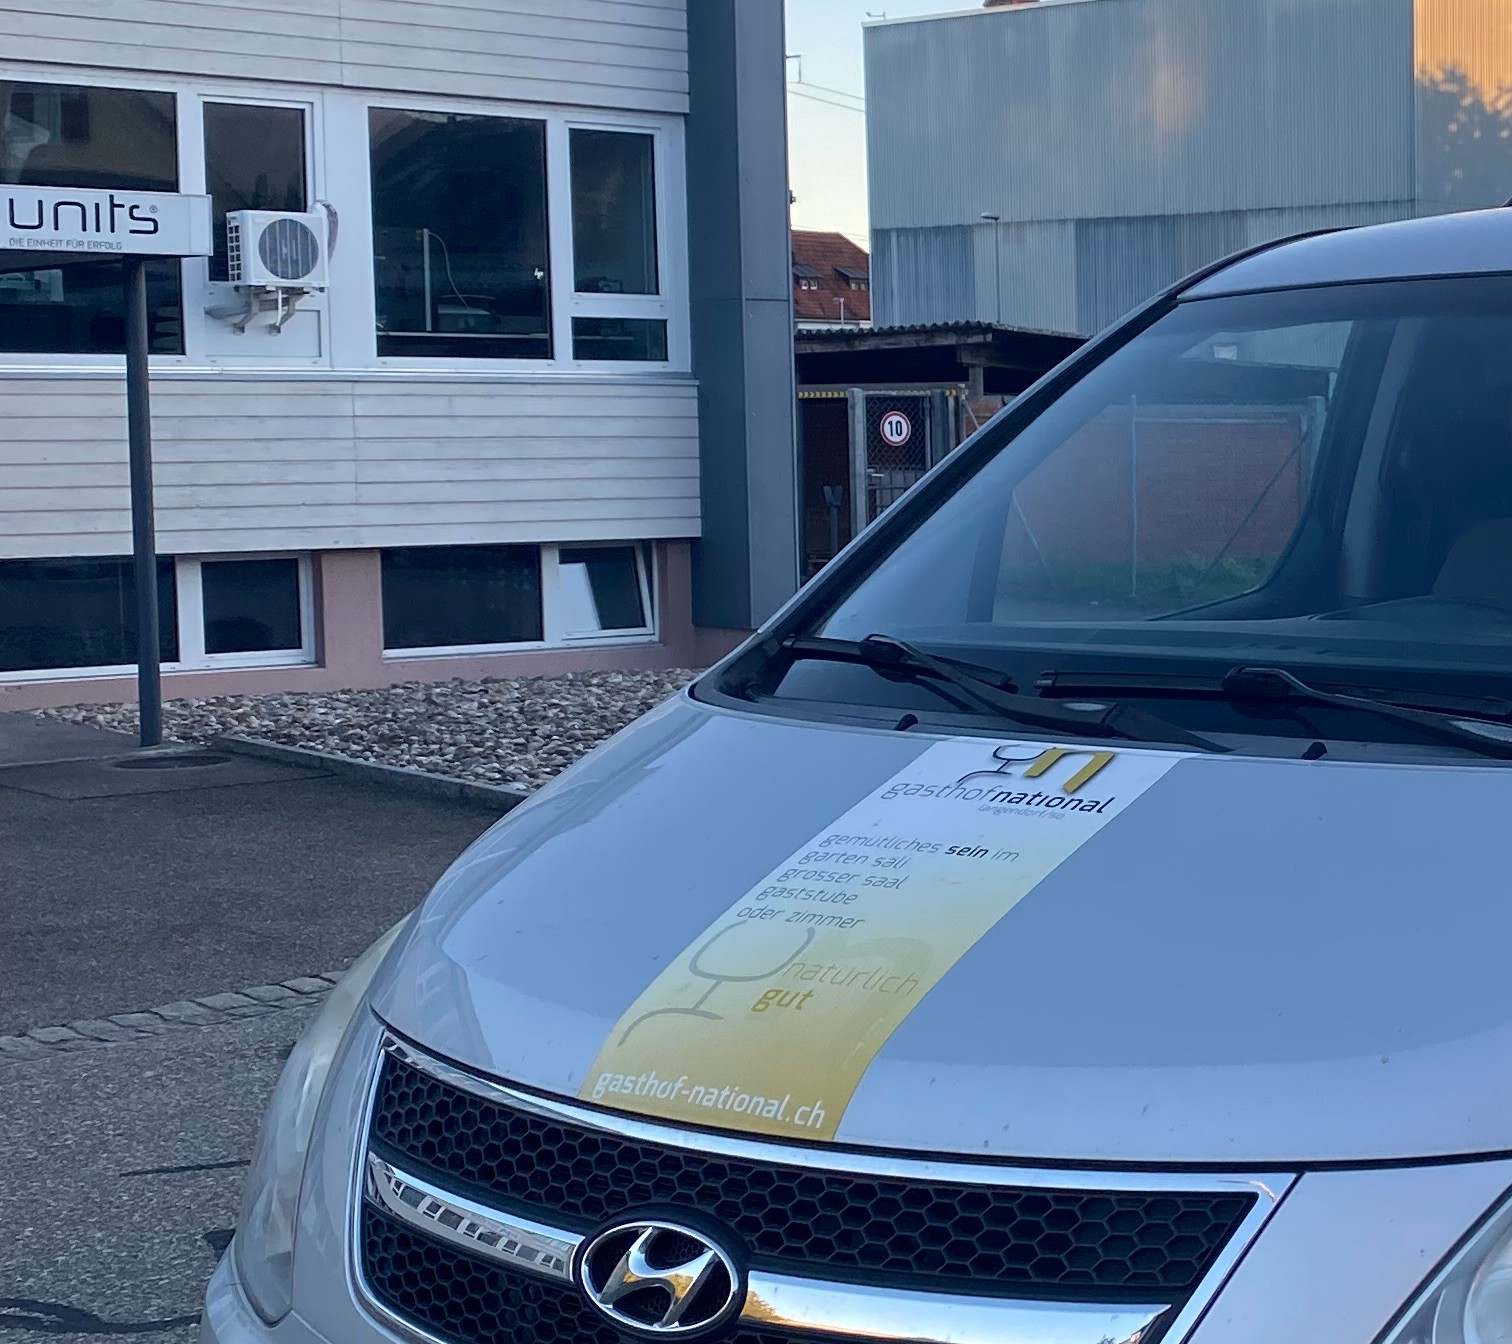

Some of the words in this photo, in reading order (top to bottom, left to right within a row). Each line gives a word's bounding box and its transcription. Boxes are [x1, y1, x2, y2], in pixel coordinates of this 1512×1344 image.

[8, 237, 24, 247] DIE
[26, 238, 64, 248] EINHEIT
[66, 238, 85, 249] FÜR
[87, 241, 123, 251] ERFOLG
[887, 419, 903, 437] 10
[798, 850, 869, 865] garten
[944, 844, 989, 859] sein
[992, 847, 1020, 863] im
[777, 866, 860, 884] grosser
[861, 875, 910, 890] saal
[756, 884, 859, 906] gaststube
[736, 905, 786, 921] oder
[785, 908, 866, 929] zimmer
[750, 987, 815, 1013] gut
[592, 1069, 826, 1129] gasthof-national.ch
